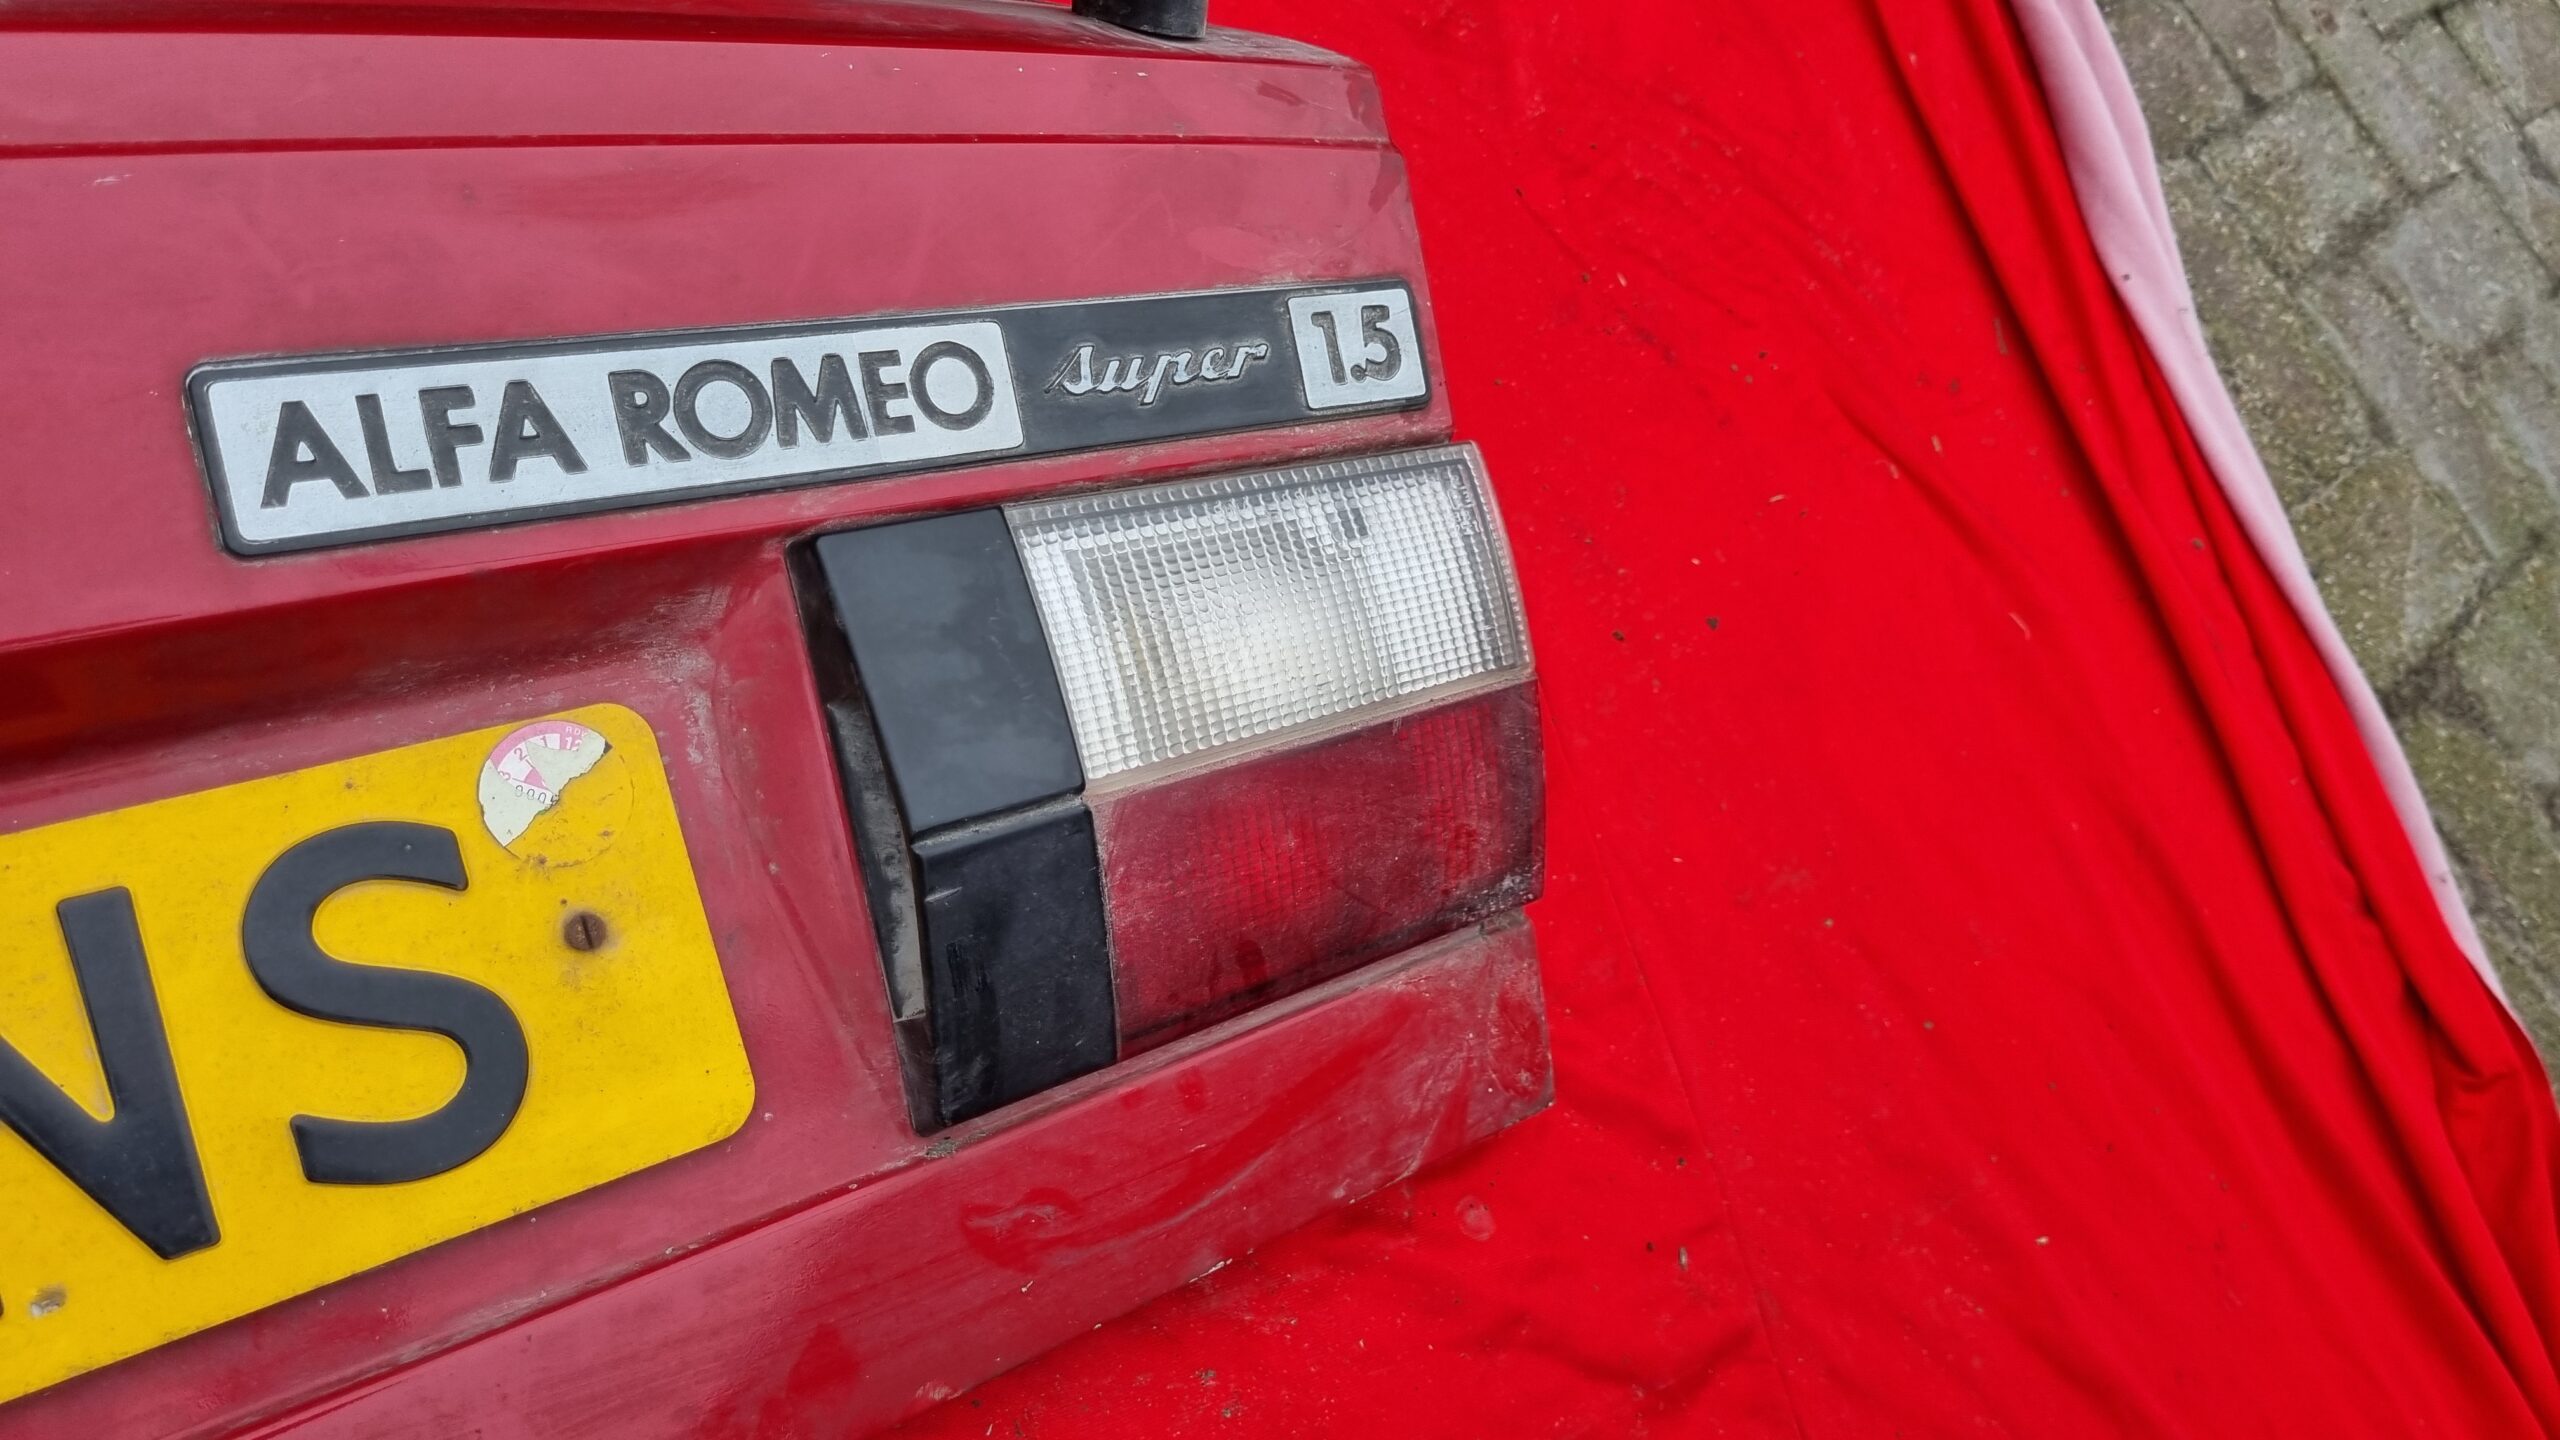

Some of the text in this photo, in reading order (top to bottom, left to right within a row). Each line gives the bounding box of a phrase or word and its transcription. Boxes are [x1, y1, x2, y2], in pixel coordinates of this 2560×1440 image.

[261, 304, 1402, 509] ALFA ROMEO super 1.5
[540, 735, 548, 748] 1
[513, 747, 528, 761] 2
